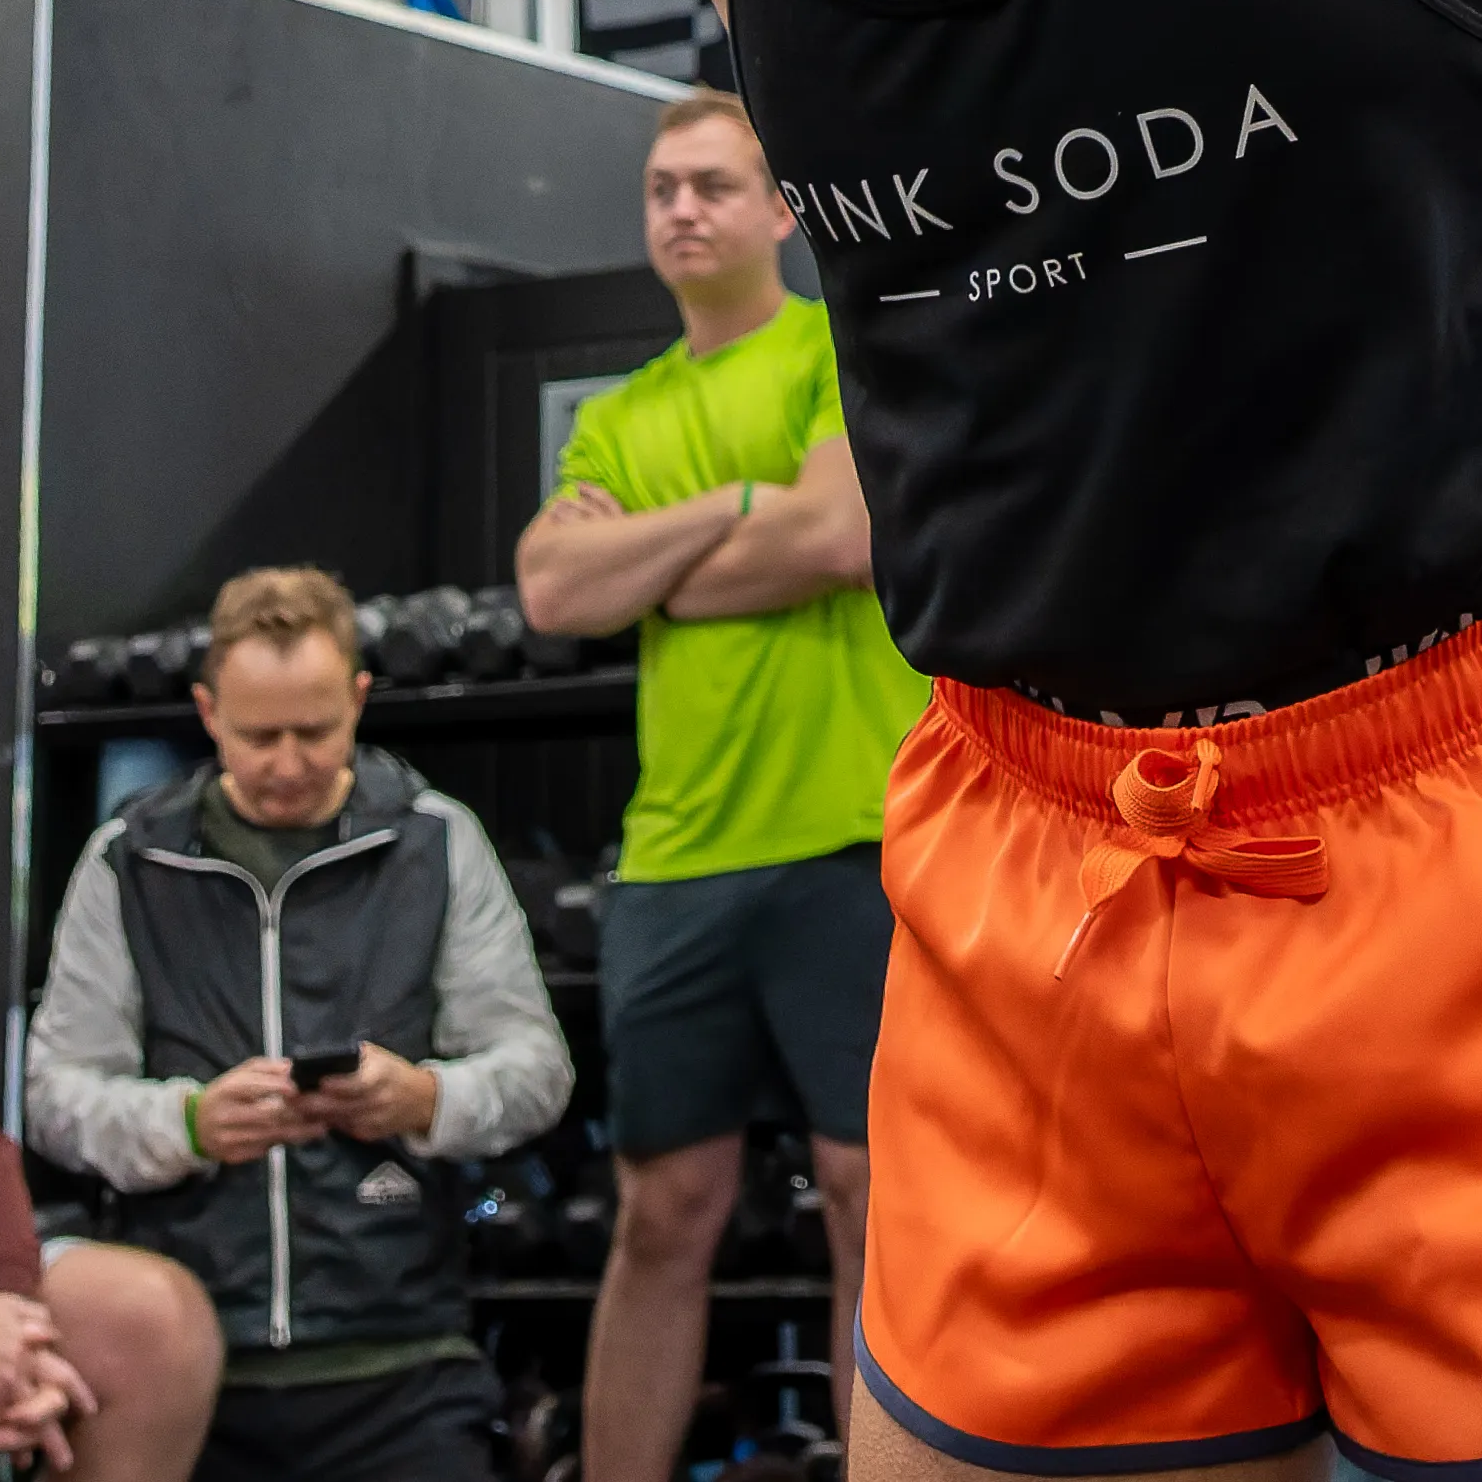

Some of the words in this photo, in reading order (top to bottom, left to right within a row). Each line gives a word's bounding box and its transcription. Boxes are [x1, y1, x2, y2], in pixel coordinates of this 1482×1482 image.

[780, 167, 954, 243] PINK
[993, 83, 1300, 216] SODA
[967, 252, 1089, 303] SPORT
